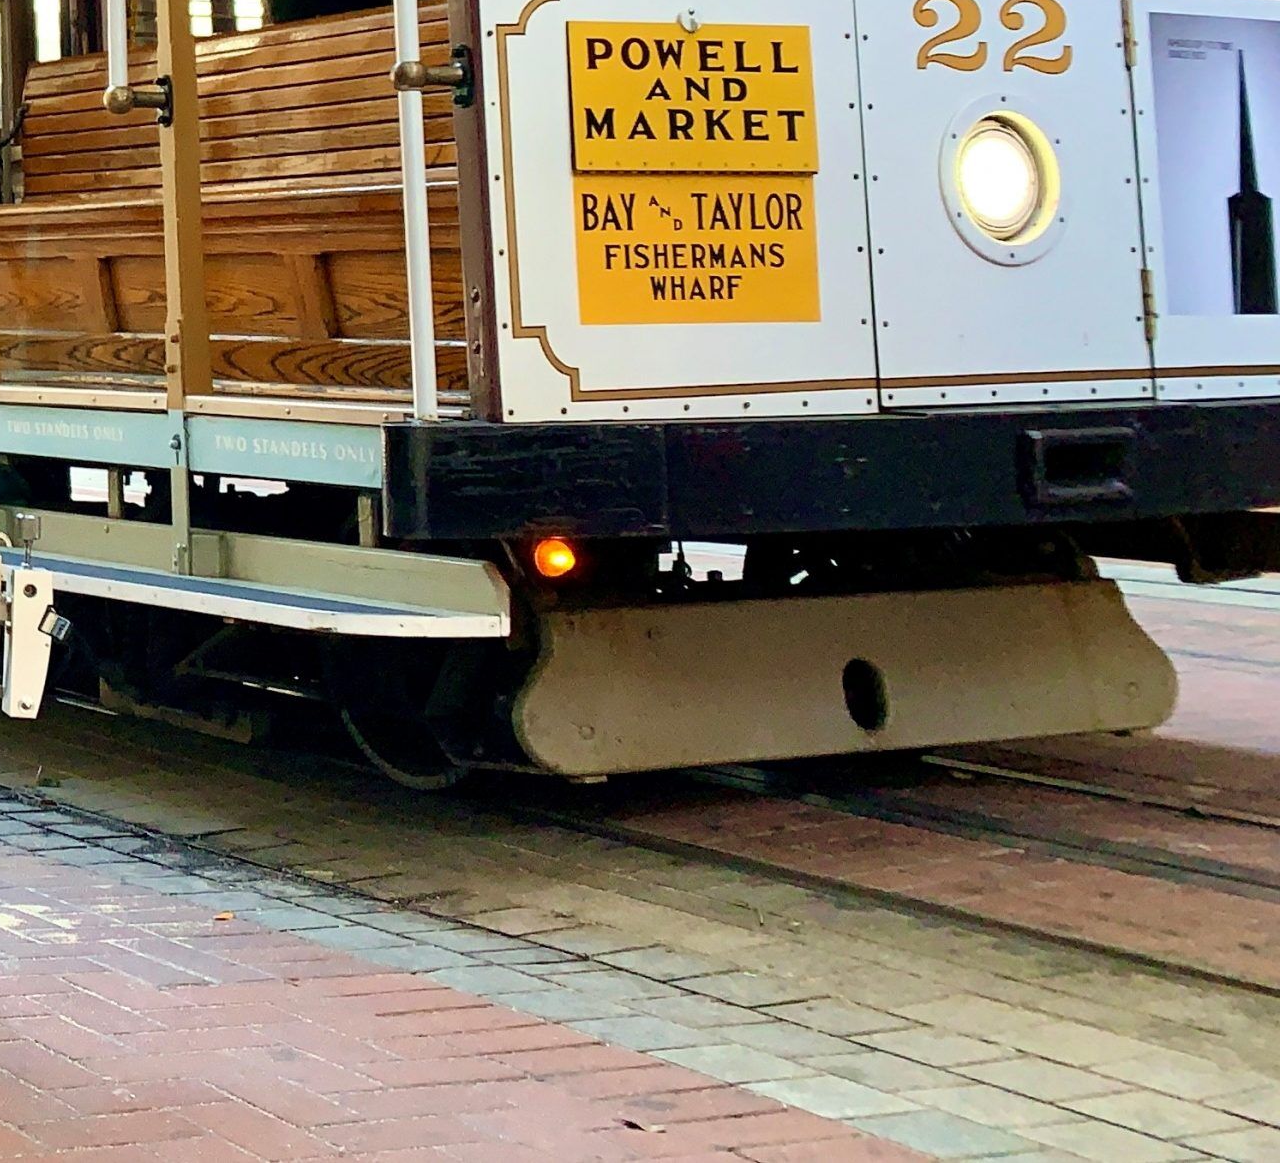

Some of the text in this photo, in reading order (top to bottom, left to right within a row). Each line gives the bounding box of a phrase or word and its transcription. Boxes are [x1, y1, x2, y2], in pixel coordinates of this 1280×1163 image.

[586, 37, 799, 73] POWELL
[645, 78, 748, 102] AND
[584, 108, 805, 141] MARKET
[582, 192, 803, 231] BAY AND TAYLOR
[605, 243, 785, 269] FISHERMANS
[650, 275, 742, 301] WHARF
[8, 420, 31, 435] TWO
[215, 435, 376, 463] TWO STANDEES ONLY
